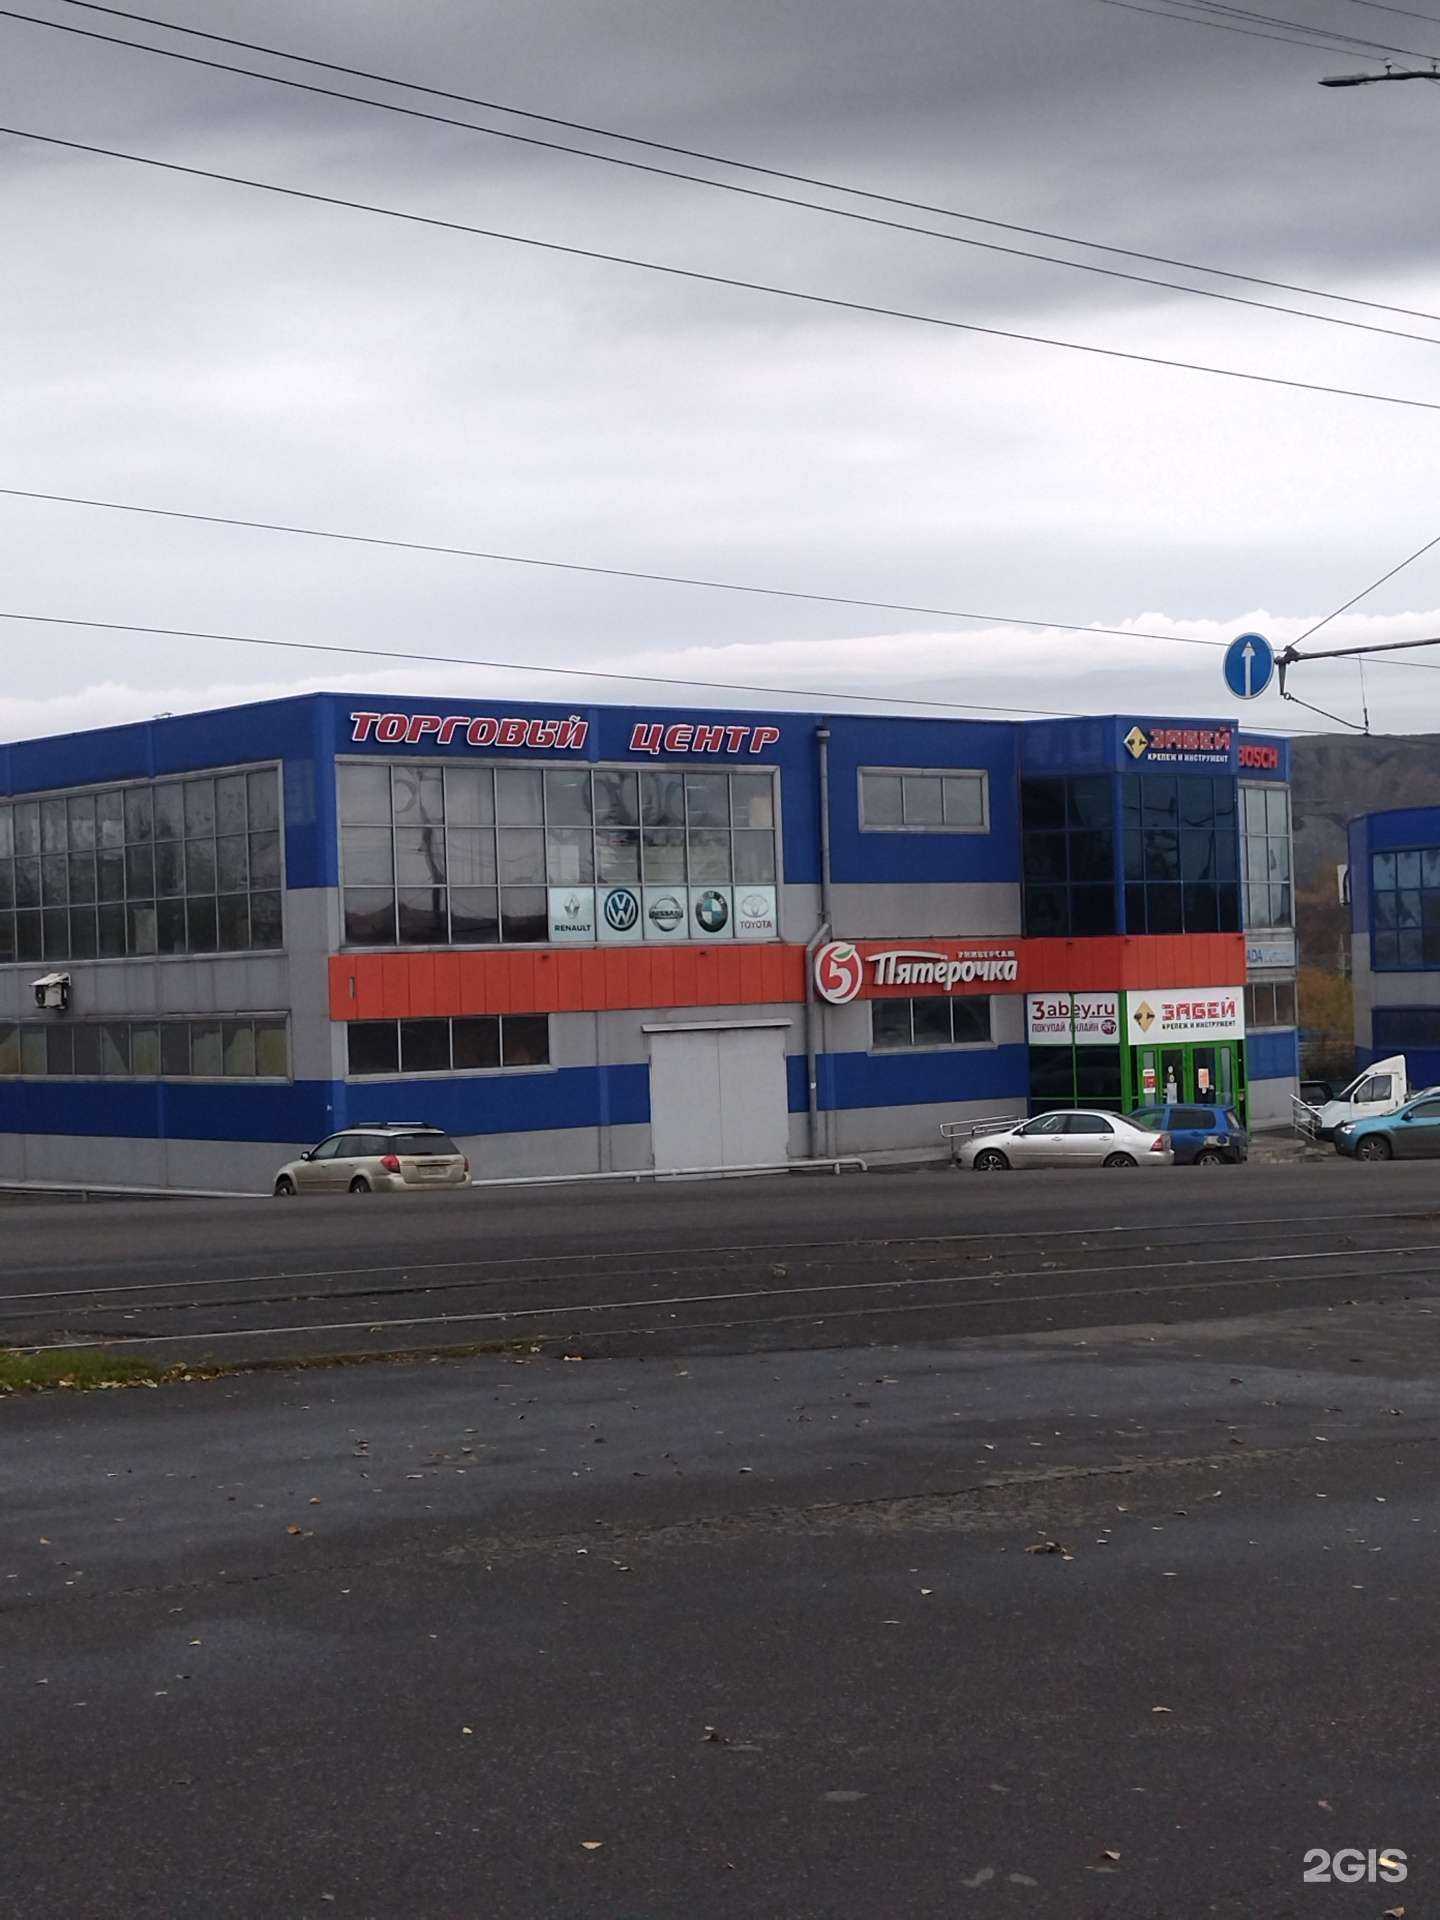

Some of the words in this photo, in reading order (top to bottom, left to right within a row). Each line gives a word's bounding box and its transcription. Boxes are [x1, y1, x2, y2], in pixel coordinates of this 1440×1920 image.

[349, 712, 590, 749] ТОРГОВЫЙ
[629, 723, 780, 756] ЦЕНТР
[554, 924, 591, 932] RENAULT
[740, 920, 772, 929] TOYOTA
[865, 951, 1018, 991] Пятерочка
